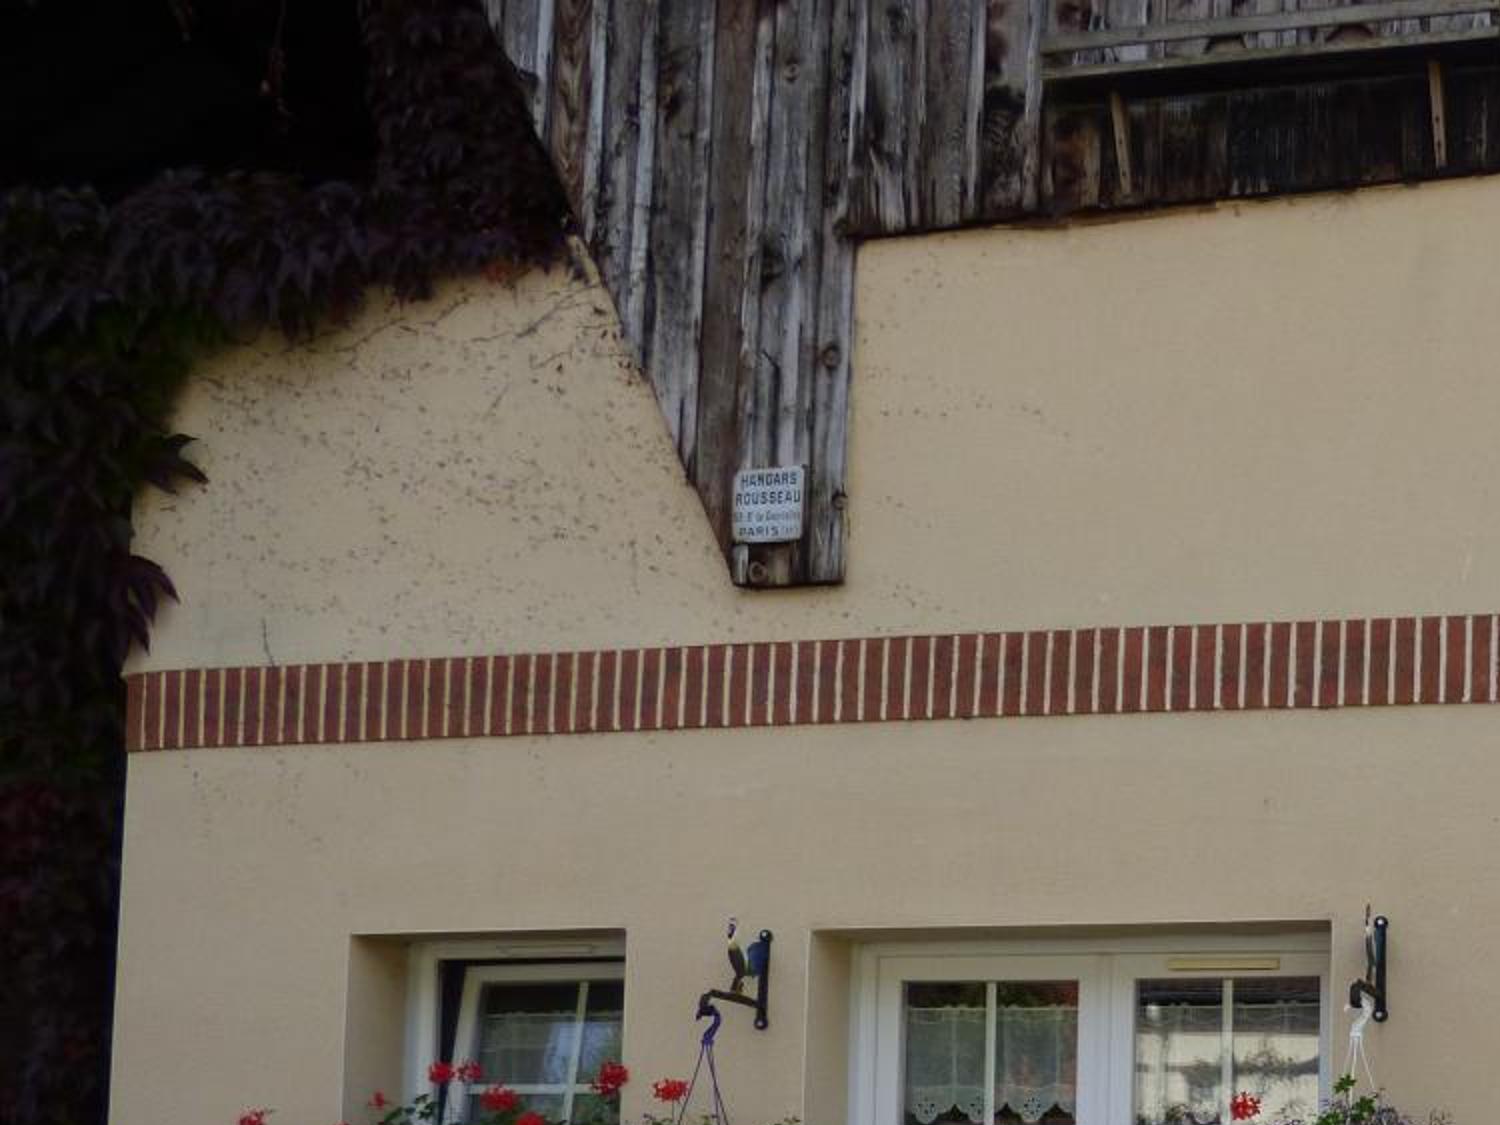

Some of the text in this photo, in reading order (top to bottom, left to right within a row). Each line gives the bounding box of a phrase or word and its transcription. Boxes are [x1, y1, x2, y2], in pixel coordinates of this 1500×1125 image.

[741, 472, 797, 487] HANGARS
[735, 490, 801, 506] ROUSSEAU
[739, 526, 779, 537] PARIS
